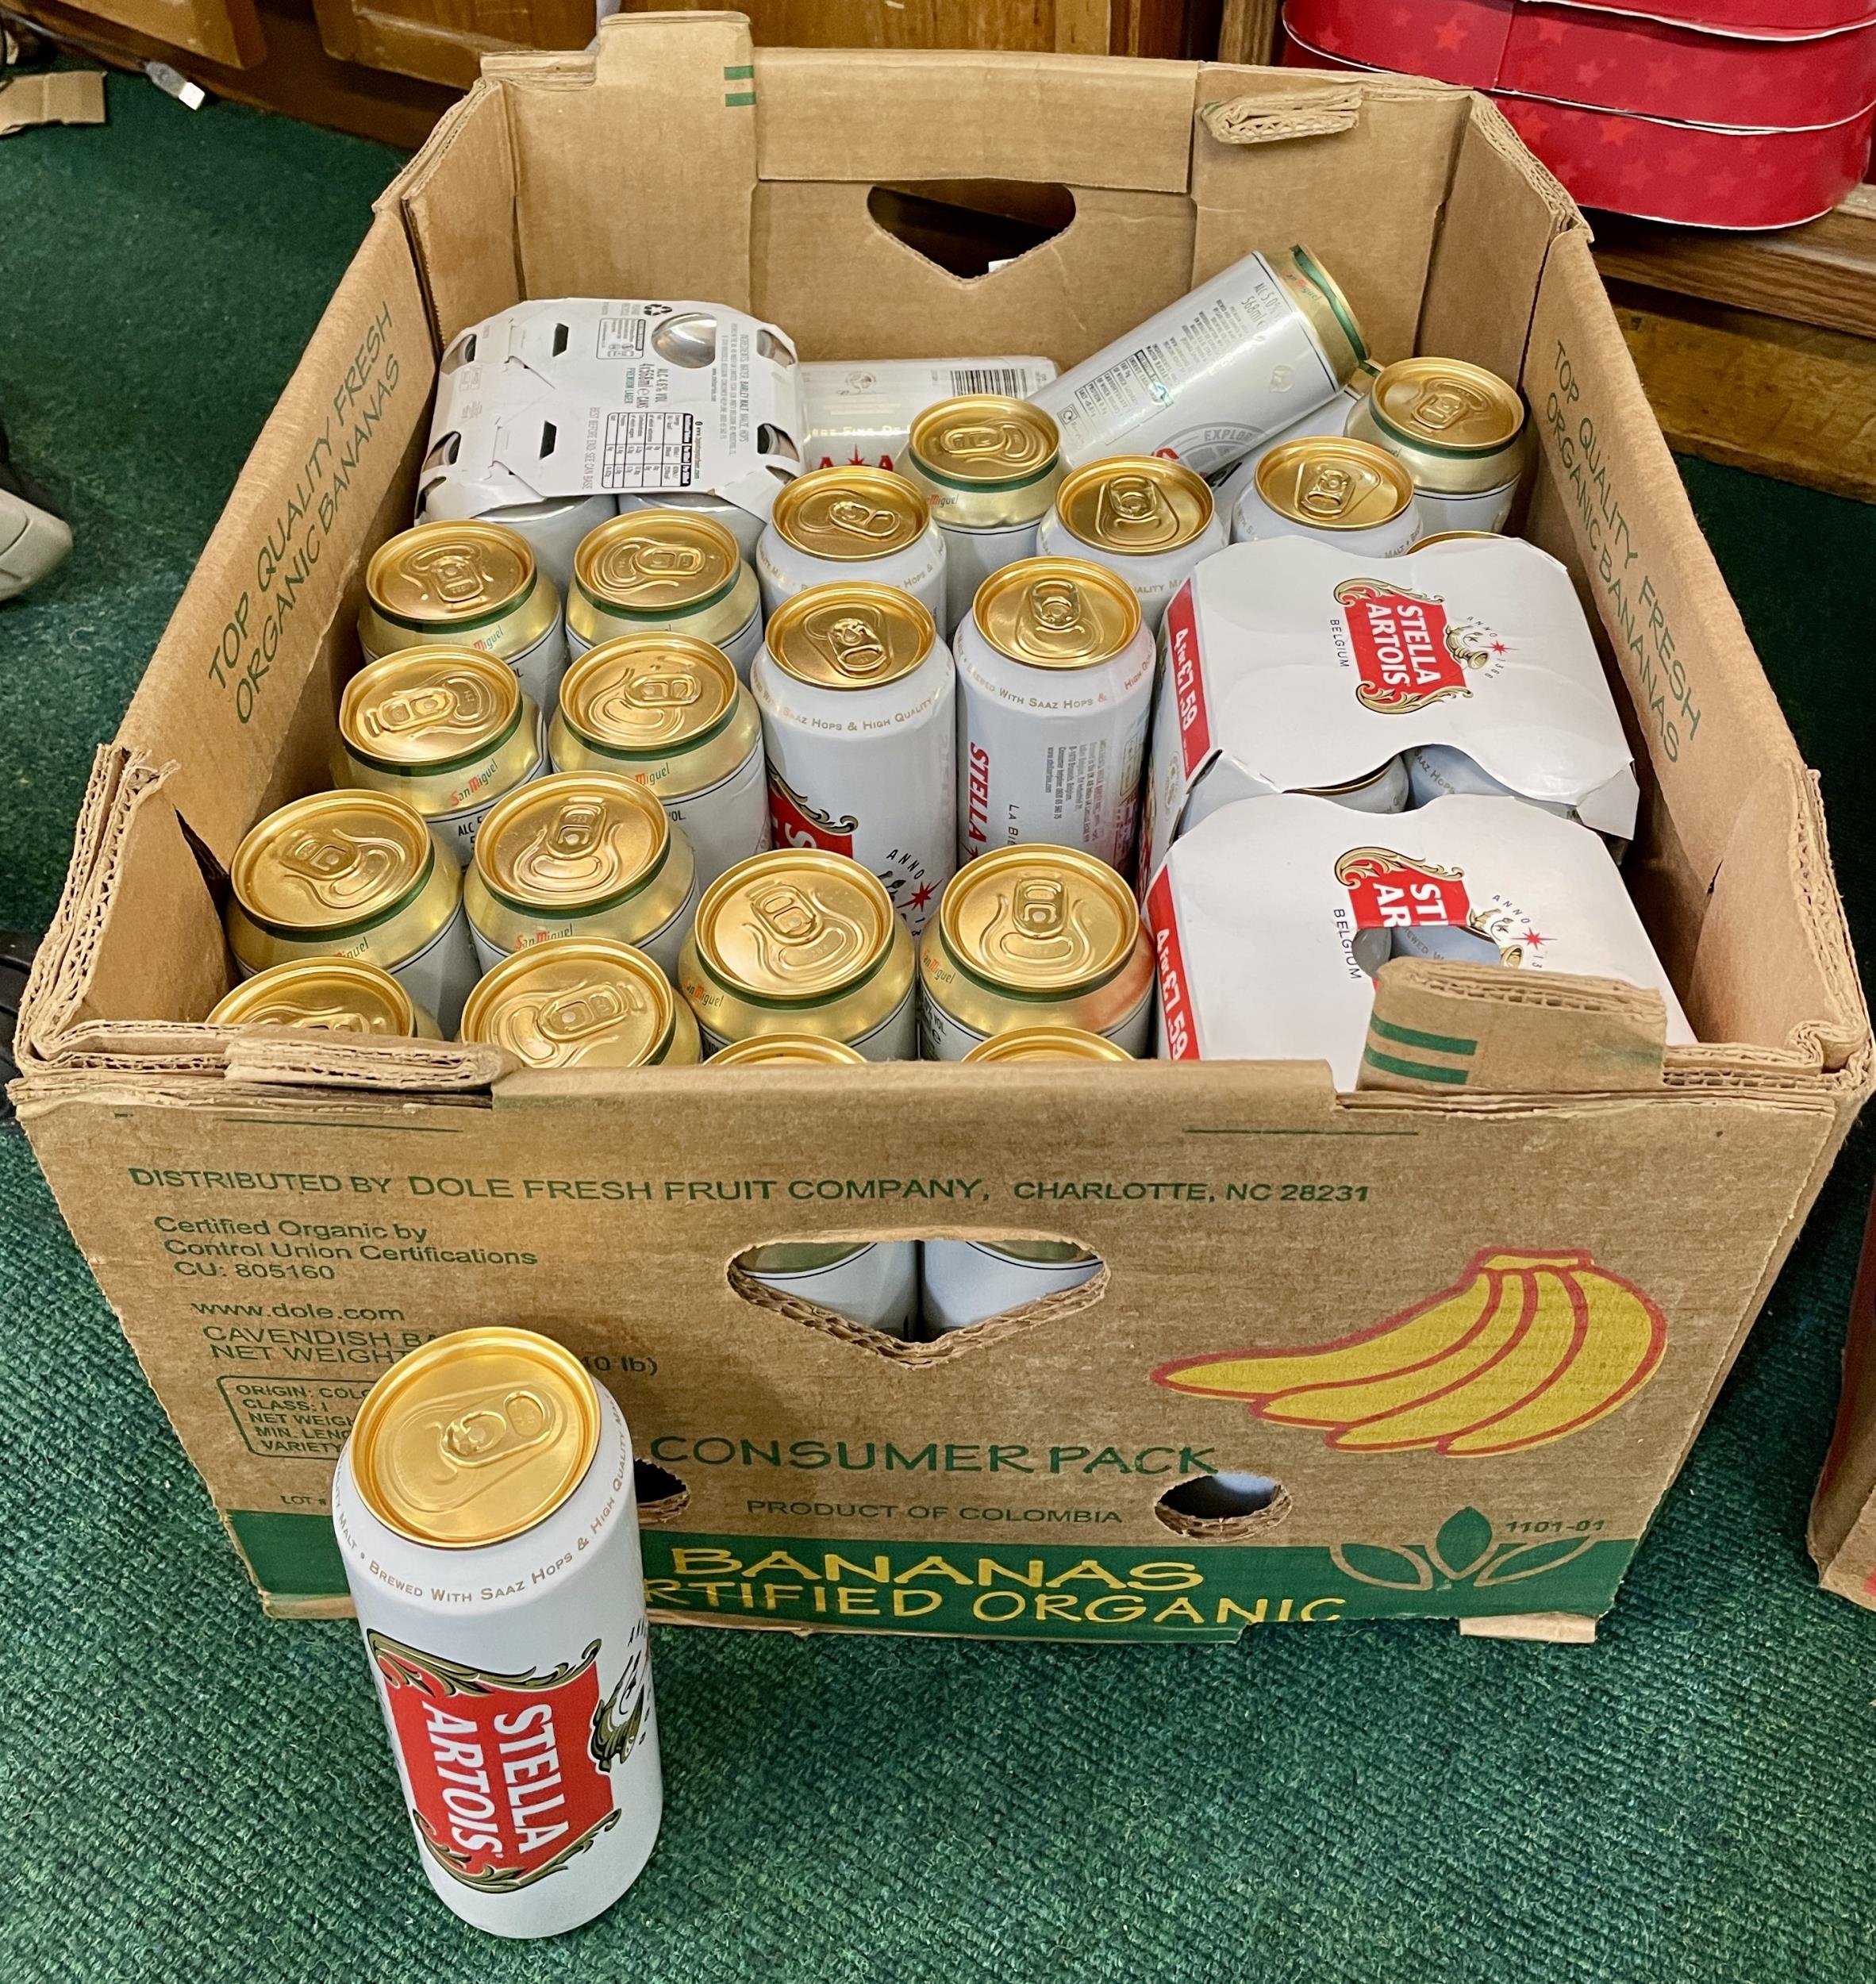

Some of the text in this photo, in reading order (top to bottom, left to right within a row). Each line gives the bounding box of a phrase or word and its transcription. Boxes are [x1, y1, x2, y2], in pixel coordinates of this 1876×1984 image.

[656, 368, 669, 378] ALC
[590, 406, 600, 419] BEST
[655, 393, 667, 403] VOL
[588, 420, 598, 439] BEFORE
[584, 463, 595, 475] CAN
[586, 452, 596, 463] SEE
[209, 302, 392, 690] TOP QUALITY FRESH
[582, 475, 594, 490] BASE
[236, 352, 400, 725] ORGANIC BANANAS
[1554, 340, 1701, 740] TOP QUALITY FRESH
[1547, 392, 1680, 763] ORGANIC BANANAS
[1174, 628, 1189, 651] 4
[1330, 619, 1349, 667] BELGIUM
[1366, 602, 1410, 686] ARTOIS
[1397, 605, 1442, 685] STELLA
[999, 687, 1024, 705] WITH
[1028, 698, 1059, 709] SAAZ
[1063, 698, 1094, 709] HOPS
[1098, 692, 1108, 703] &
[1124, 671, 1143, 690] HIGH
[1177, 659, 1197, 731] £7.59
[812, 717, 843, 731] HOPS
[848, 721, 857, 731] &
[863, 717, 891, 730] HIGH
[894, 698, 934, 723] QUALITY
[968, 741, 990, 843] STELLA
[458, 821, 475, 836] ALC
[886, 849, 925, 879] ANNO
[1409, 883, 1449, 926] ST
[1492, 894, 1531, 925] ANNO
[1157, 929, 1171, 954] 4
[1333, 909, 1362, 979] BELGIUM
[1163, 970, 1189, 1061] £7.59
[129, 1167, 1370, 1203] DISTRIBUTED BY DOLE FRESH FRUIT COMPANY, CHARLOTTE, NC 28231
[153, 1215, 428, 1244] Certified Organic by
[165, 1239, 539, 1266] Control Union Certifications
[174, 1260, 335, 1281] CU: 805160
[190, 1302, 406, 1321] www.dole.com
[202, 1325, 392, 1348] CAVENDISH
[210, 1344, 272, 1361] NET
[621, 1357, 658, 1376] lb)
[236, 1384, 315, 1398] ORIGIN:
[242, 1398, 317, 1412] CLASS:
[248, 1411, 289, 1424] NET
[254, 1426, 298, 1439] MIN.
[261, 1440, 344, 1454] VARIETY
[651, 1435, 1220, 1475] CONSUMER PACK
[280, 1495, 314, 1505] LOT
[748, 1500, 1123, 1524] PRODUCT OF COLOMBIA
[339, 1511, 357, 1549] MALT
[369, 1559, 424, 1598] BREWED
[431, 1586, 472, 1603] WITH
[481, 1580, 525, 1601] SAAZ
[531, 1551, 573, 1586] HOPS
[577, 1536, 590, 1551] &
[590, 1498, 616, 1535] HIGH
[613, 1434, 627, 1492] QUALITY
[1505, 1520, 1605, 1533] 1101-01
[672, 1548, 1205, 1591] BANANAS
[644, 1578, 1347, 1624] RTIFIED ORGANIC
[422, 1700, 502, 1856] ARTOIS
[494, 1703, 569, 1854] STELLA
